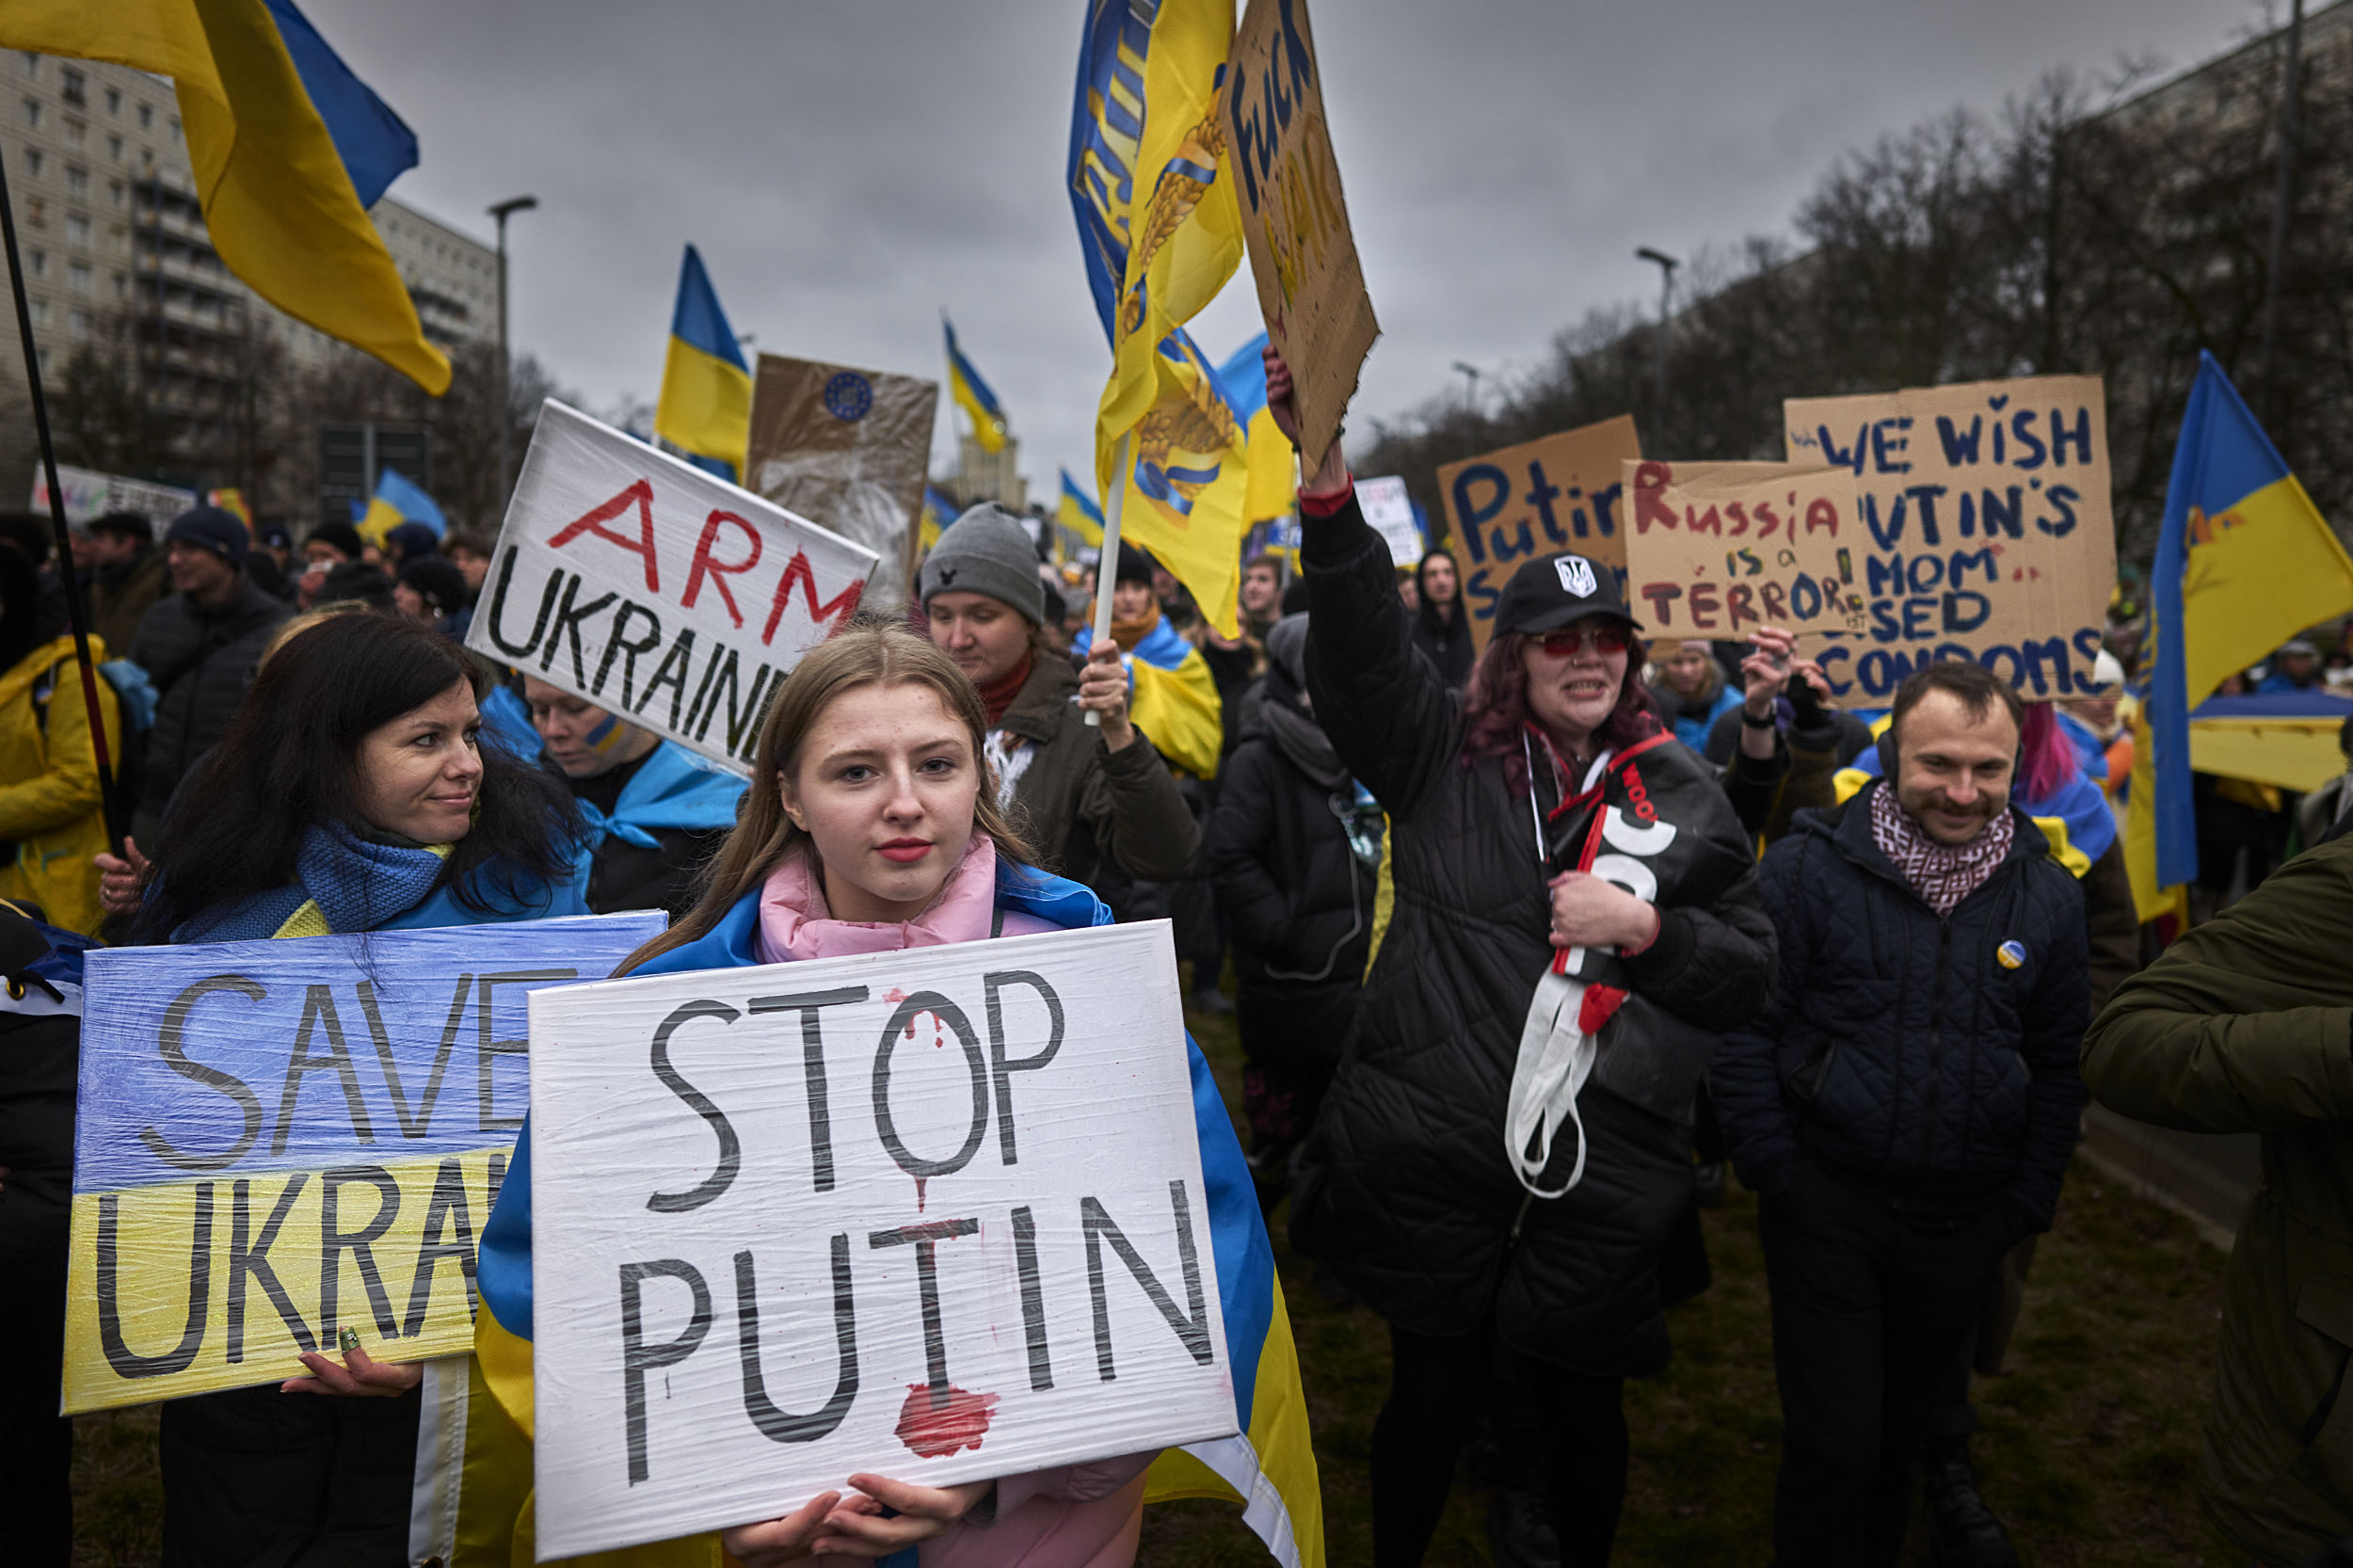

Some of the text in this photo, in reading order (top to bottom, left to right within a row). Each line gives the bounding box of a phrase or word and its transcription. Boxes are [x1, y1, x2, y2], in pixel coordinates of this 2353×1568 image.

[1817, 417, 1914, 477] WE
[547, 477, 865, 647] ARM
[1858, 476, 2082, 553] UTIN'S
[1866, 546, 1998, 598] MOM
[1822, 591, 1992, 644] SED
[137, 968, 577, 1171] SAVE
[645, 969, 1065, 1213] STOP
[619, 1179, 1213, 1488] PUTIN
